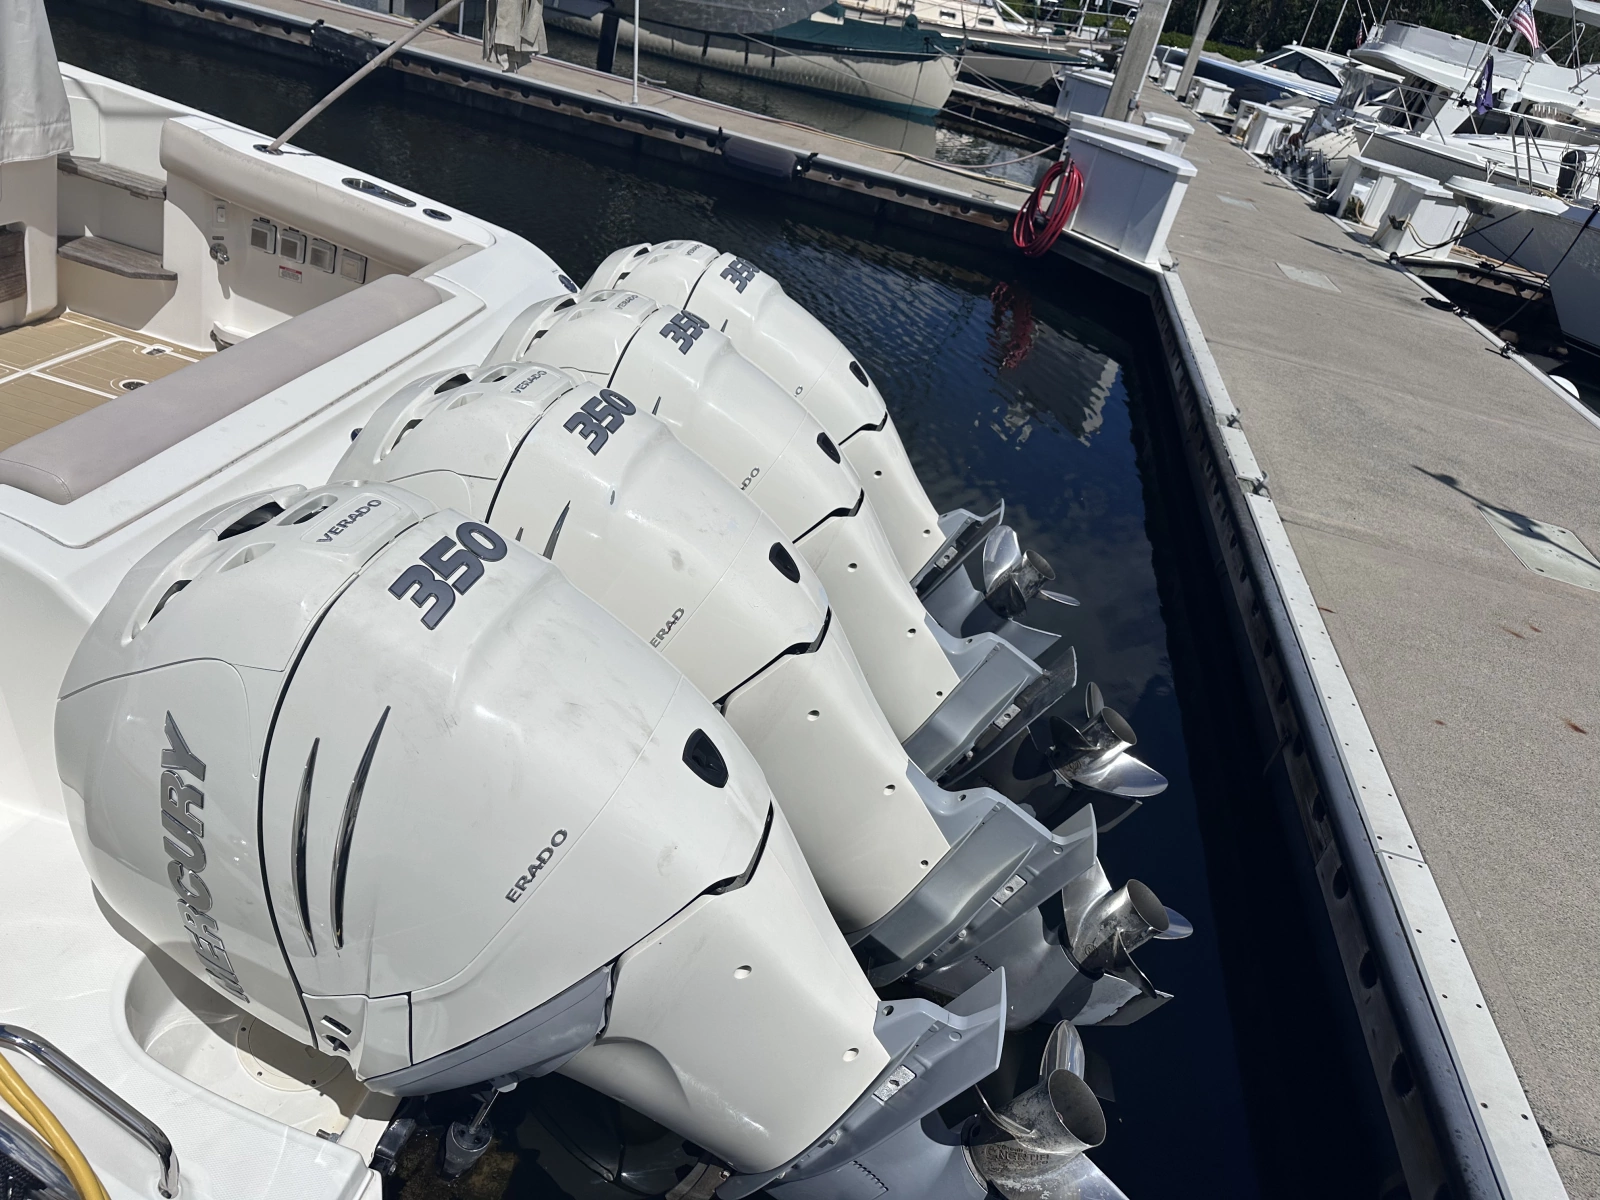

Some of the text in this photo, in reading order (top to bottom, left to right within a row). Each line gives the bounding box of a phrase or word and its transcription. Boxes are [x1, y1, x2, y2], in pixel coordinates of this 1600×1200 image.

[720, 257, 760, 294] 350
[659, 310, 710, 355] 350
[510, 370, 547, 394] VERADO
[563, 389, 636, 456] 350
[316, 500, 382, 543] VERADO
[388, 522, 508, 630] 350
[161, 710, 250, 1003] MERCURY
